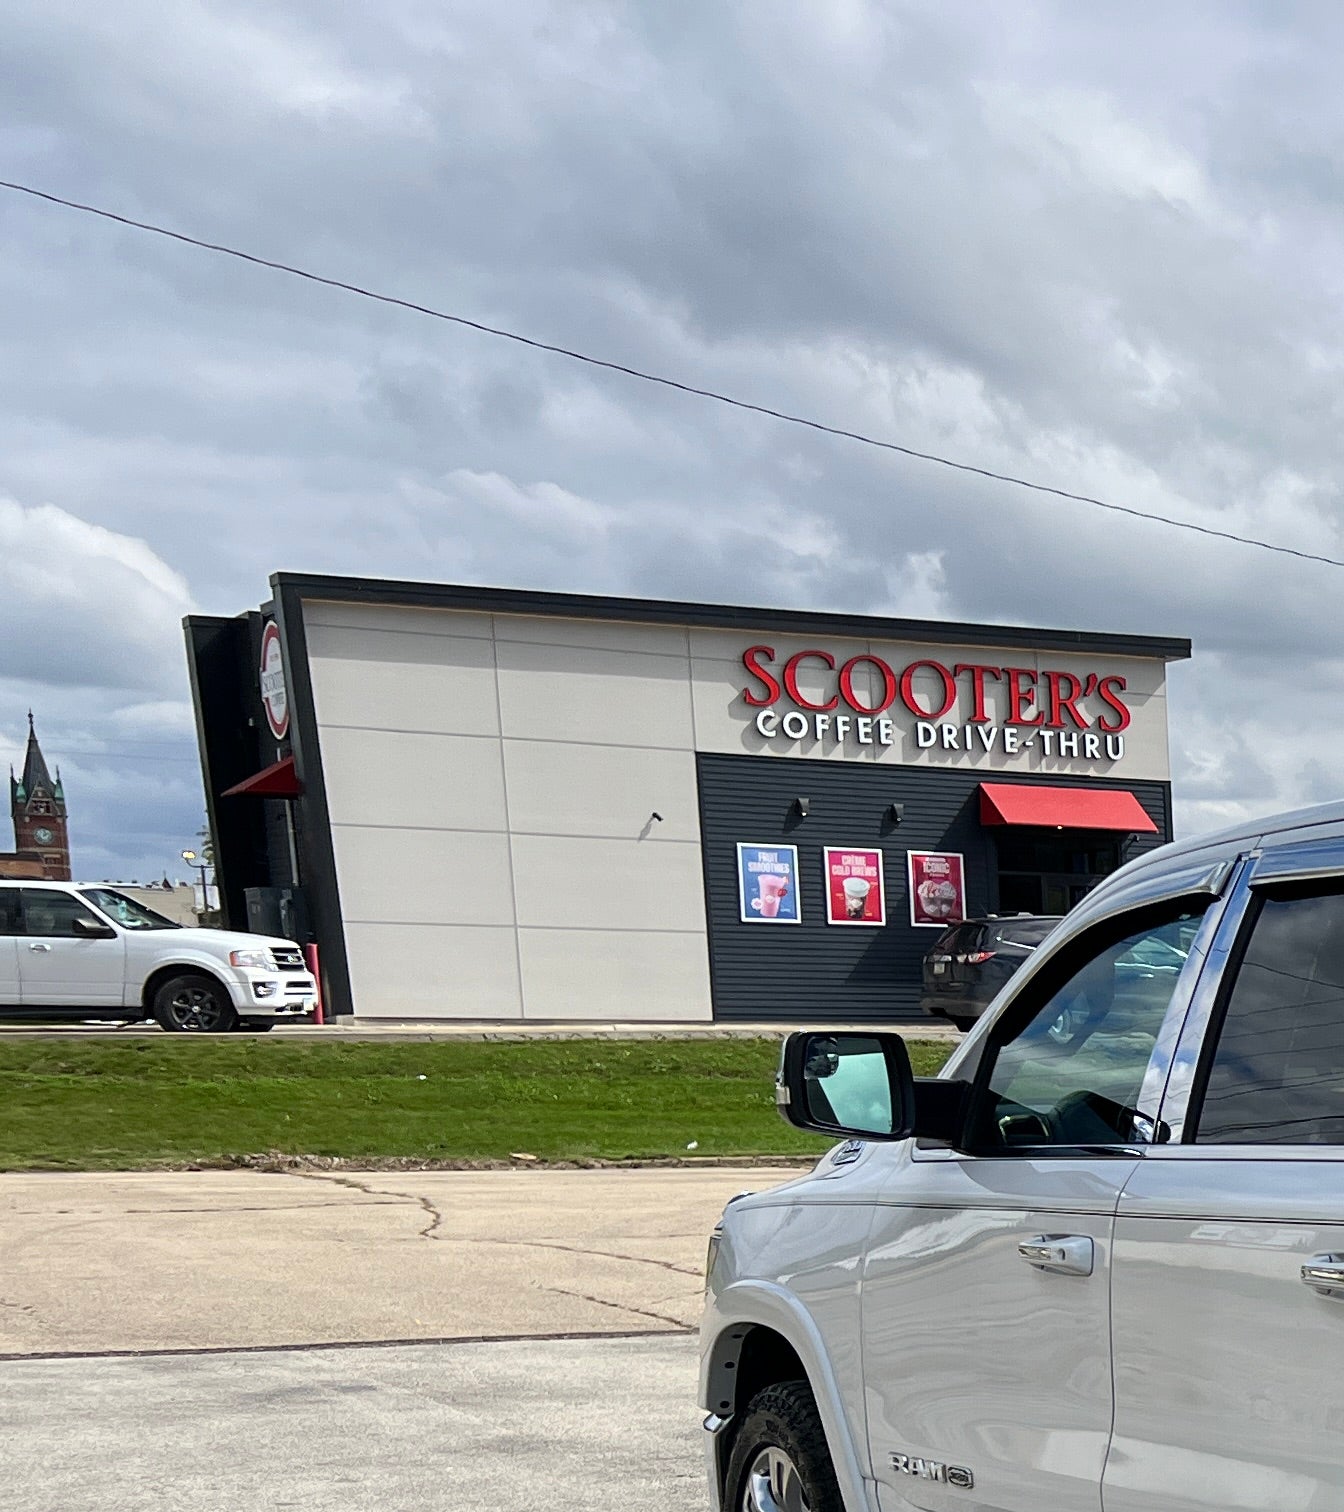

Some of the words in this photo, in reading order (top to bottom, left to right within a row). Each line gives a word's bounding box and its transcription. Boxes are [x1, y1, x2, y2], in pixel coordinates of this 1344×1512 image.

[742, 645, 1132, 733] SCOOTER'S
[755, 709, 896, 746] COFFEE
[916, 721, 1126, 761] DRIVE-THRU
